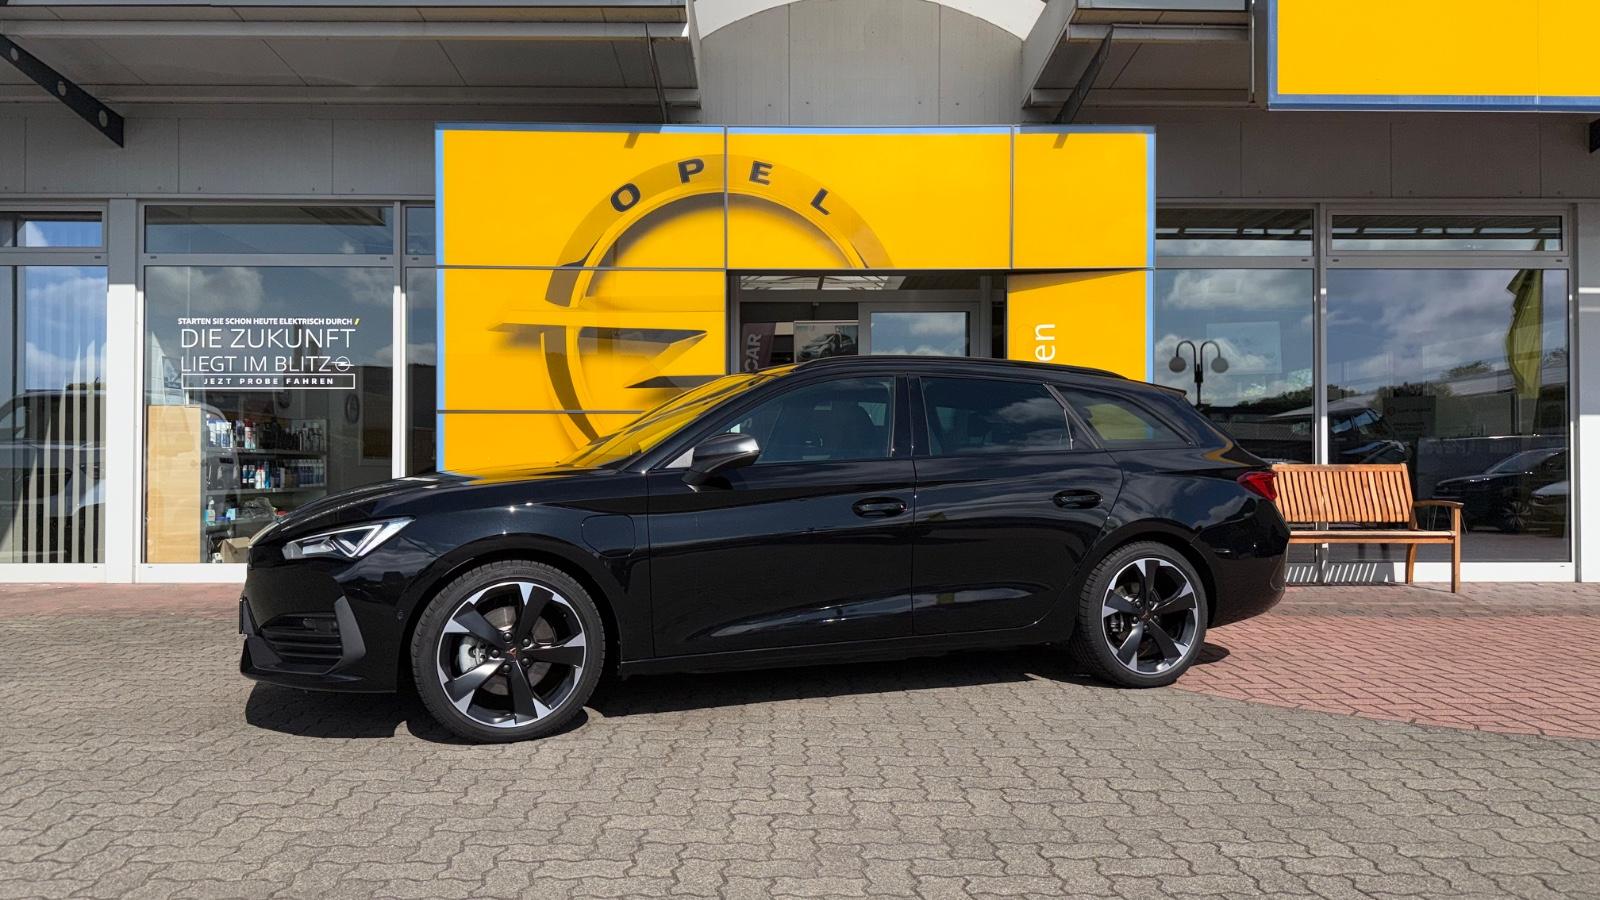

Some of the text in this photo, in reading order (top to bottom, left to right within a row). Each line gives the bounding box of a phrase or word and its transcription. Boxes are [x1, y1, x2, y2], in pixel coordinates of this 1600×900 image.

[610, 158, 831, 216] OPEL
[177, 317, 353, 325] STARTEN SIE SCHON HEUTE ELEKTRISCH DURCH
[181, 328, 356, 349] DIE ZUKUNFT
[180, 355, 332, 372] LIEGT IM BLITZ
[203, 377, 334, 385] JEZT PROBE FAHREN
